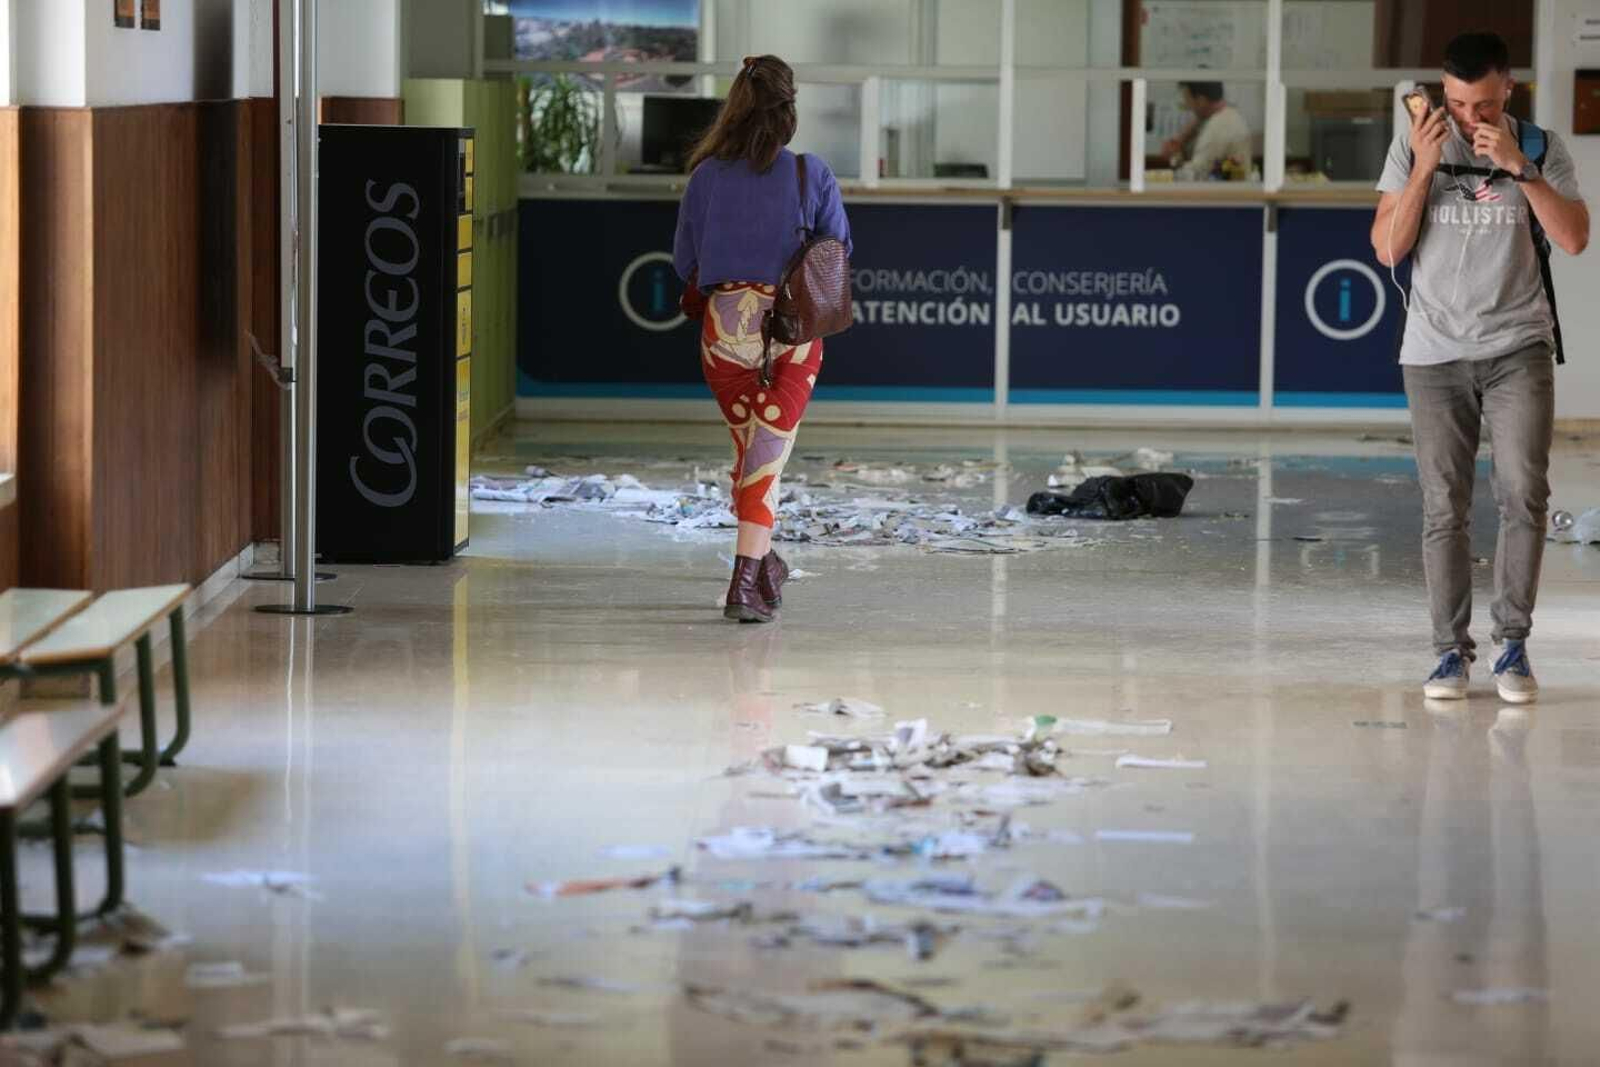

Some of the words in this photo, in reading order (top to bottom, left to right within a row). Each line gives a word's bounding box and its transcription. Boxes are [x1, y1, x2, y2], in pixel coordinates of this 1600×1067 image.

[1430, 204, 1527, 225] HOLLISTER
[1012, 267, 1168, 300] CONSERJERÍA
[852, 297, 990, 325] ATENCIÓN
[1012, 302, 1047, 326] AL
[1054, 303, 1181, 327] USUARIO
[350, 179, 420, 508] CORREOS
